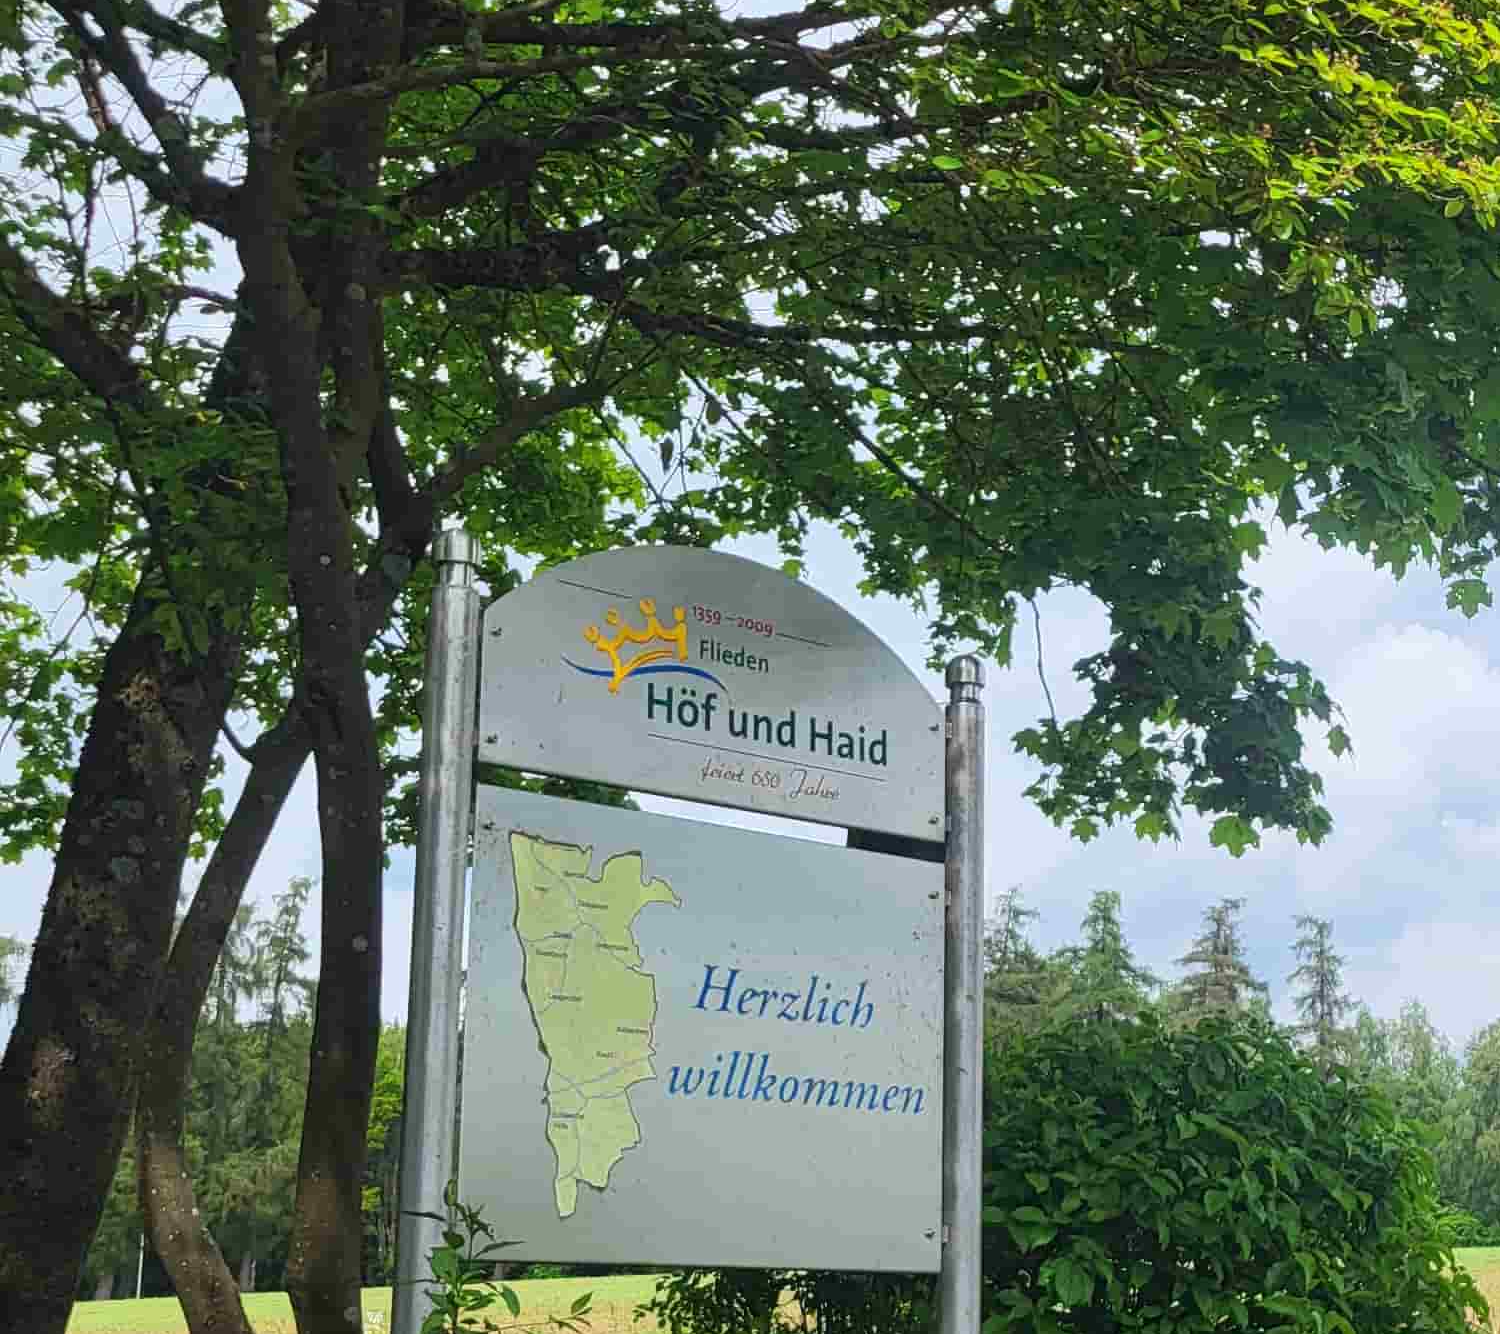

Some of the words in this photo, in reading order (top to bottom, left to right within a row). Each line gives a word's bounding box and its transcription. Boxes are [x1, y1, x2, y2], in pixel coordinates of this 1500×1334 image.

[692, 603, 722, 625] 1359
[737, 617, 775, 637] 2009
[699, 638, 769, 673] Flieden
[647, 682, 718, 732] Höf
[728, 708, 796, 749] und
[808, 716, 888, 766] Haid
[789, 766, 841, 800] Jahre
[695, 964, 874, 1028] Herzlich
[666, 1051, 927, 1116] willkommen
